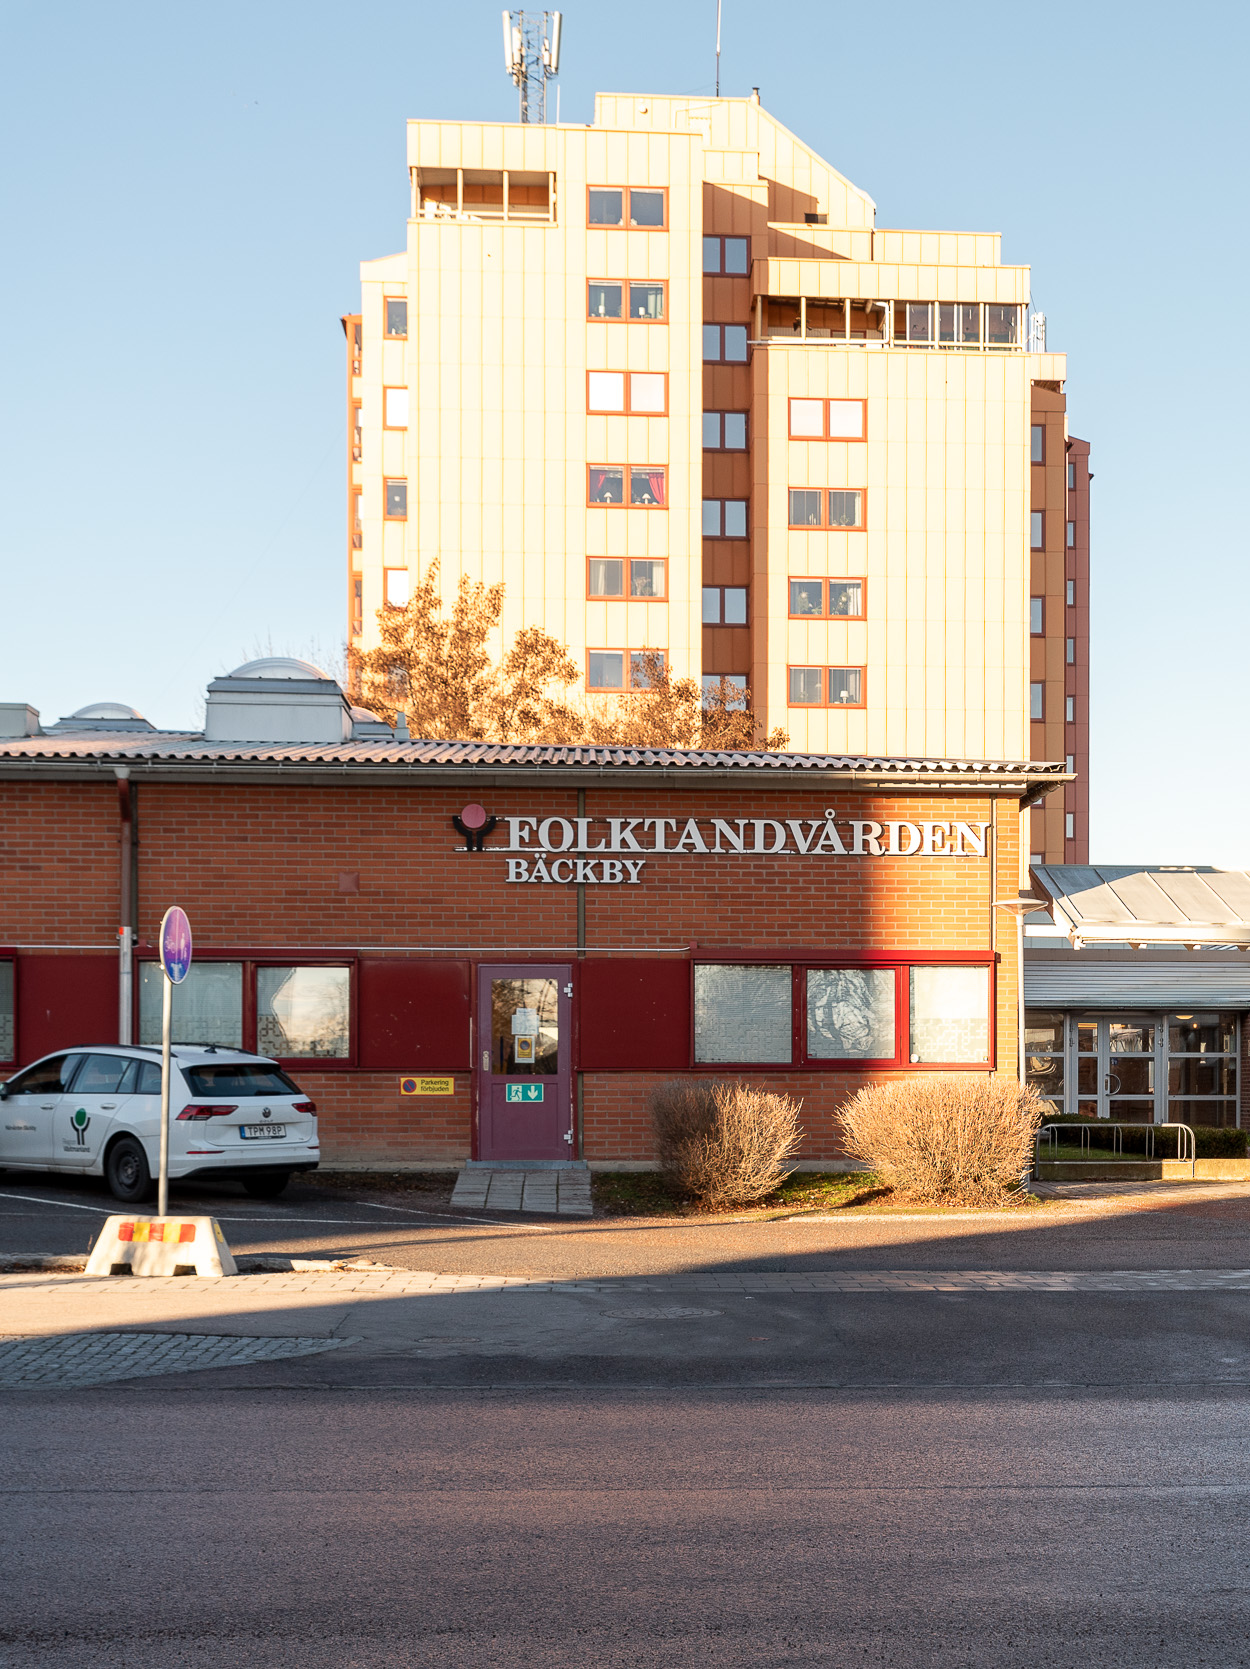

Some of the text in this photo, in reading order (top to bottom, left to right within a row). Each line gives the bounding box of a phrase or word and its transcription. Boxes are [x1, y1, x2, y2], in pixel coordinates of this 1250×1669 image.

[505, 808, 990, 857] FOLKTANDVÅRDEN
[505, 852, 646, 884] BÄCKBY
[248, 1126, 282, 1136] TPM 98P
